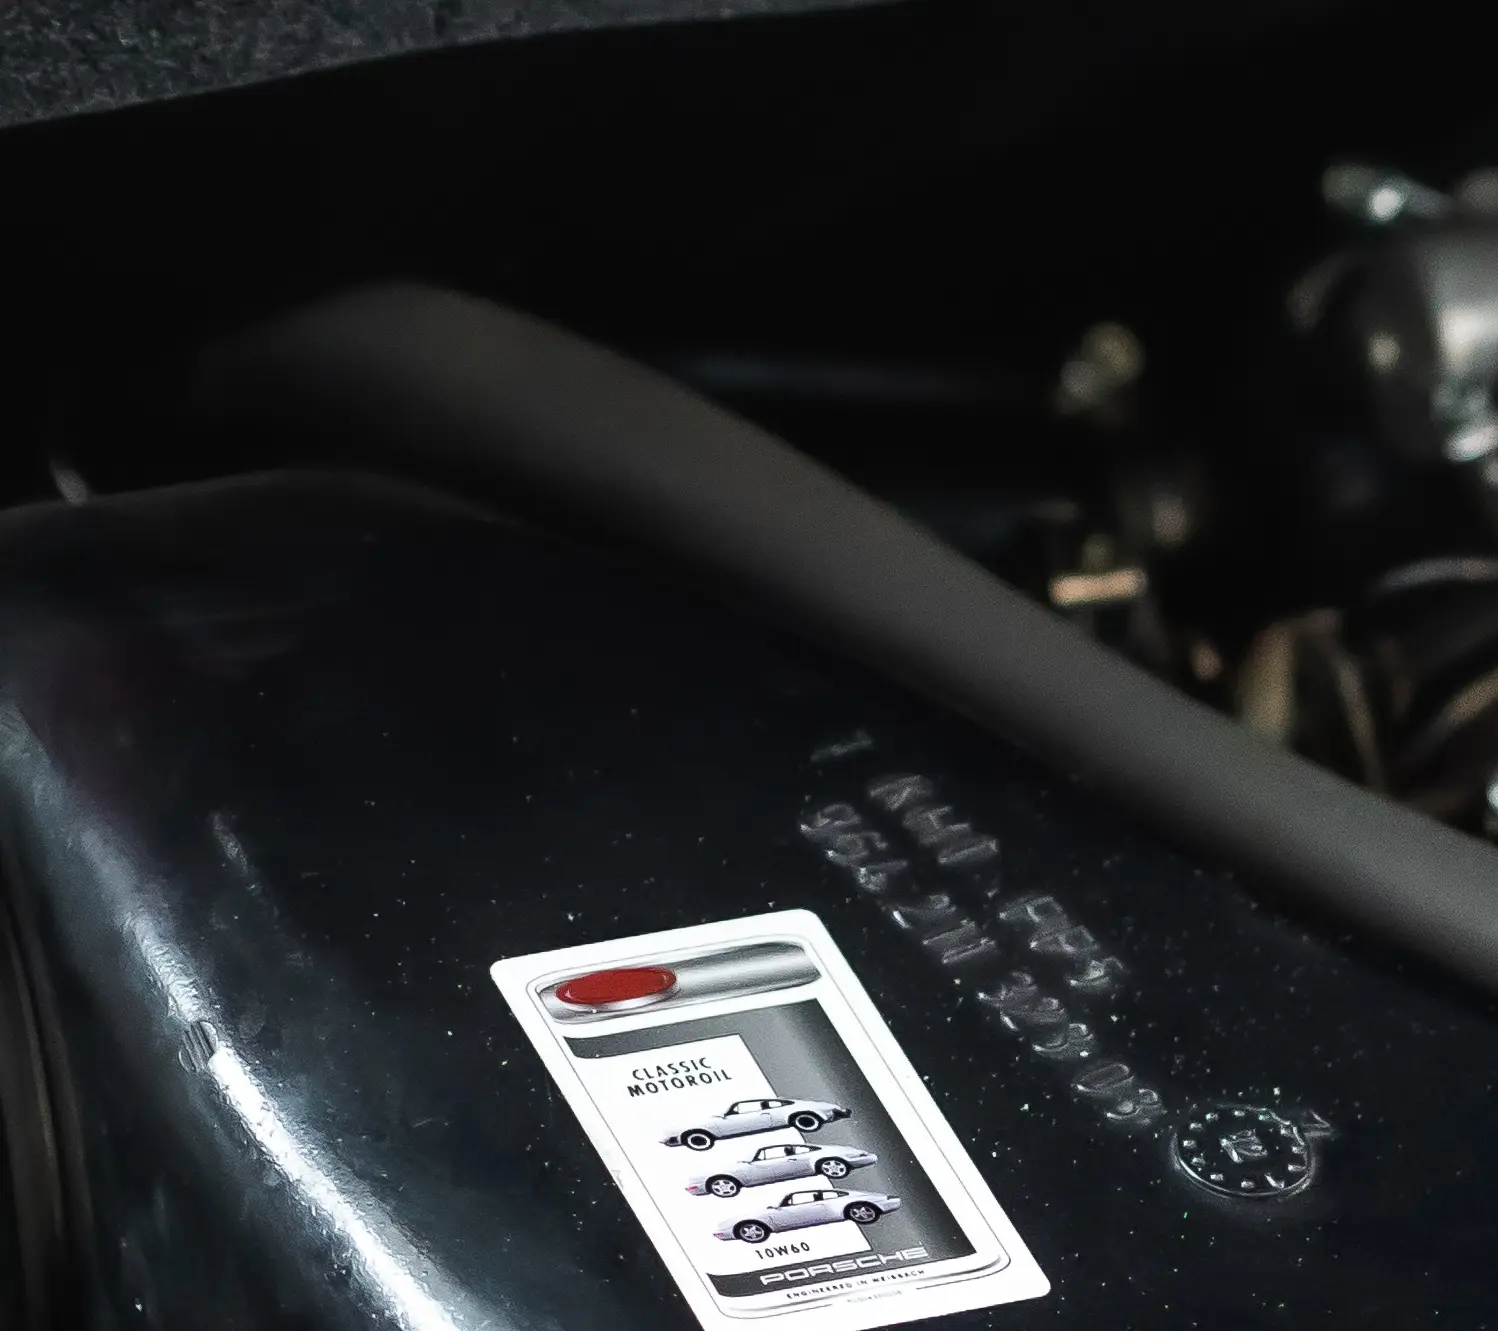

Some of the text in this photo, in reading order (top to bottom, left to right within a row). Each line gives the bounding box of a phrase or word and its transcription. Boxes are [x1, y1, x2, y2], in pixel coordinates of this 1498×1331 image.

[632, 1057, 711, 1080] CLASSIC
[627, 1069, 732, 1097] MOTOROIL
[754, 1241, 810, 1260] 10W60
[759, 1246, 928, 1285] PORSCHE
[786, 1282, 851, 1300] ENGINEERED
[856, 1278, 868, 1287] IN
